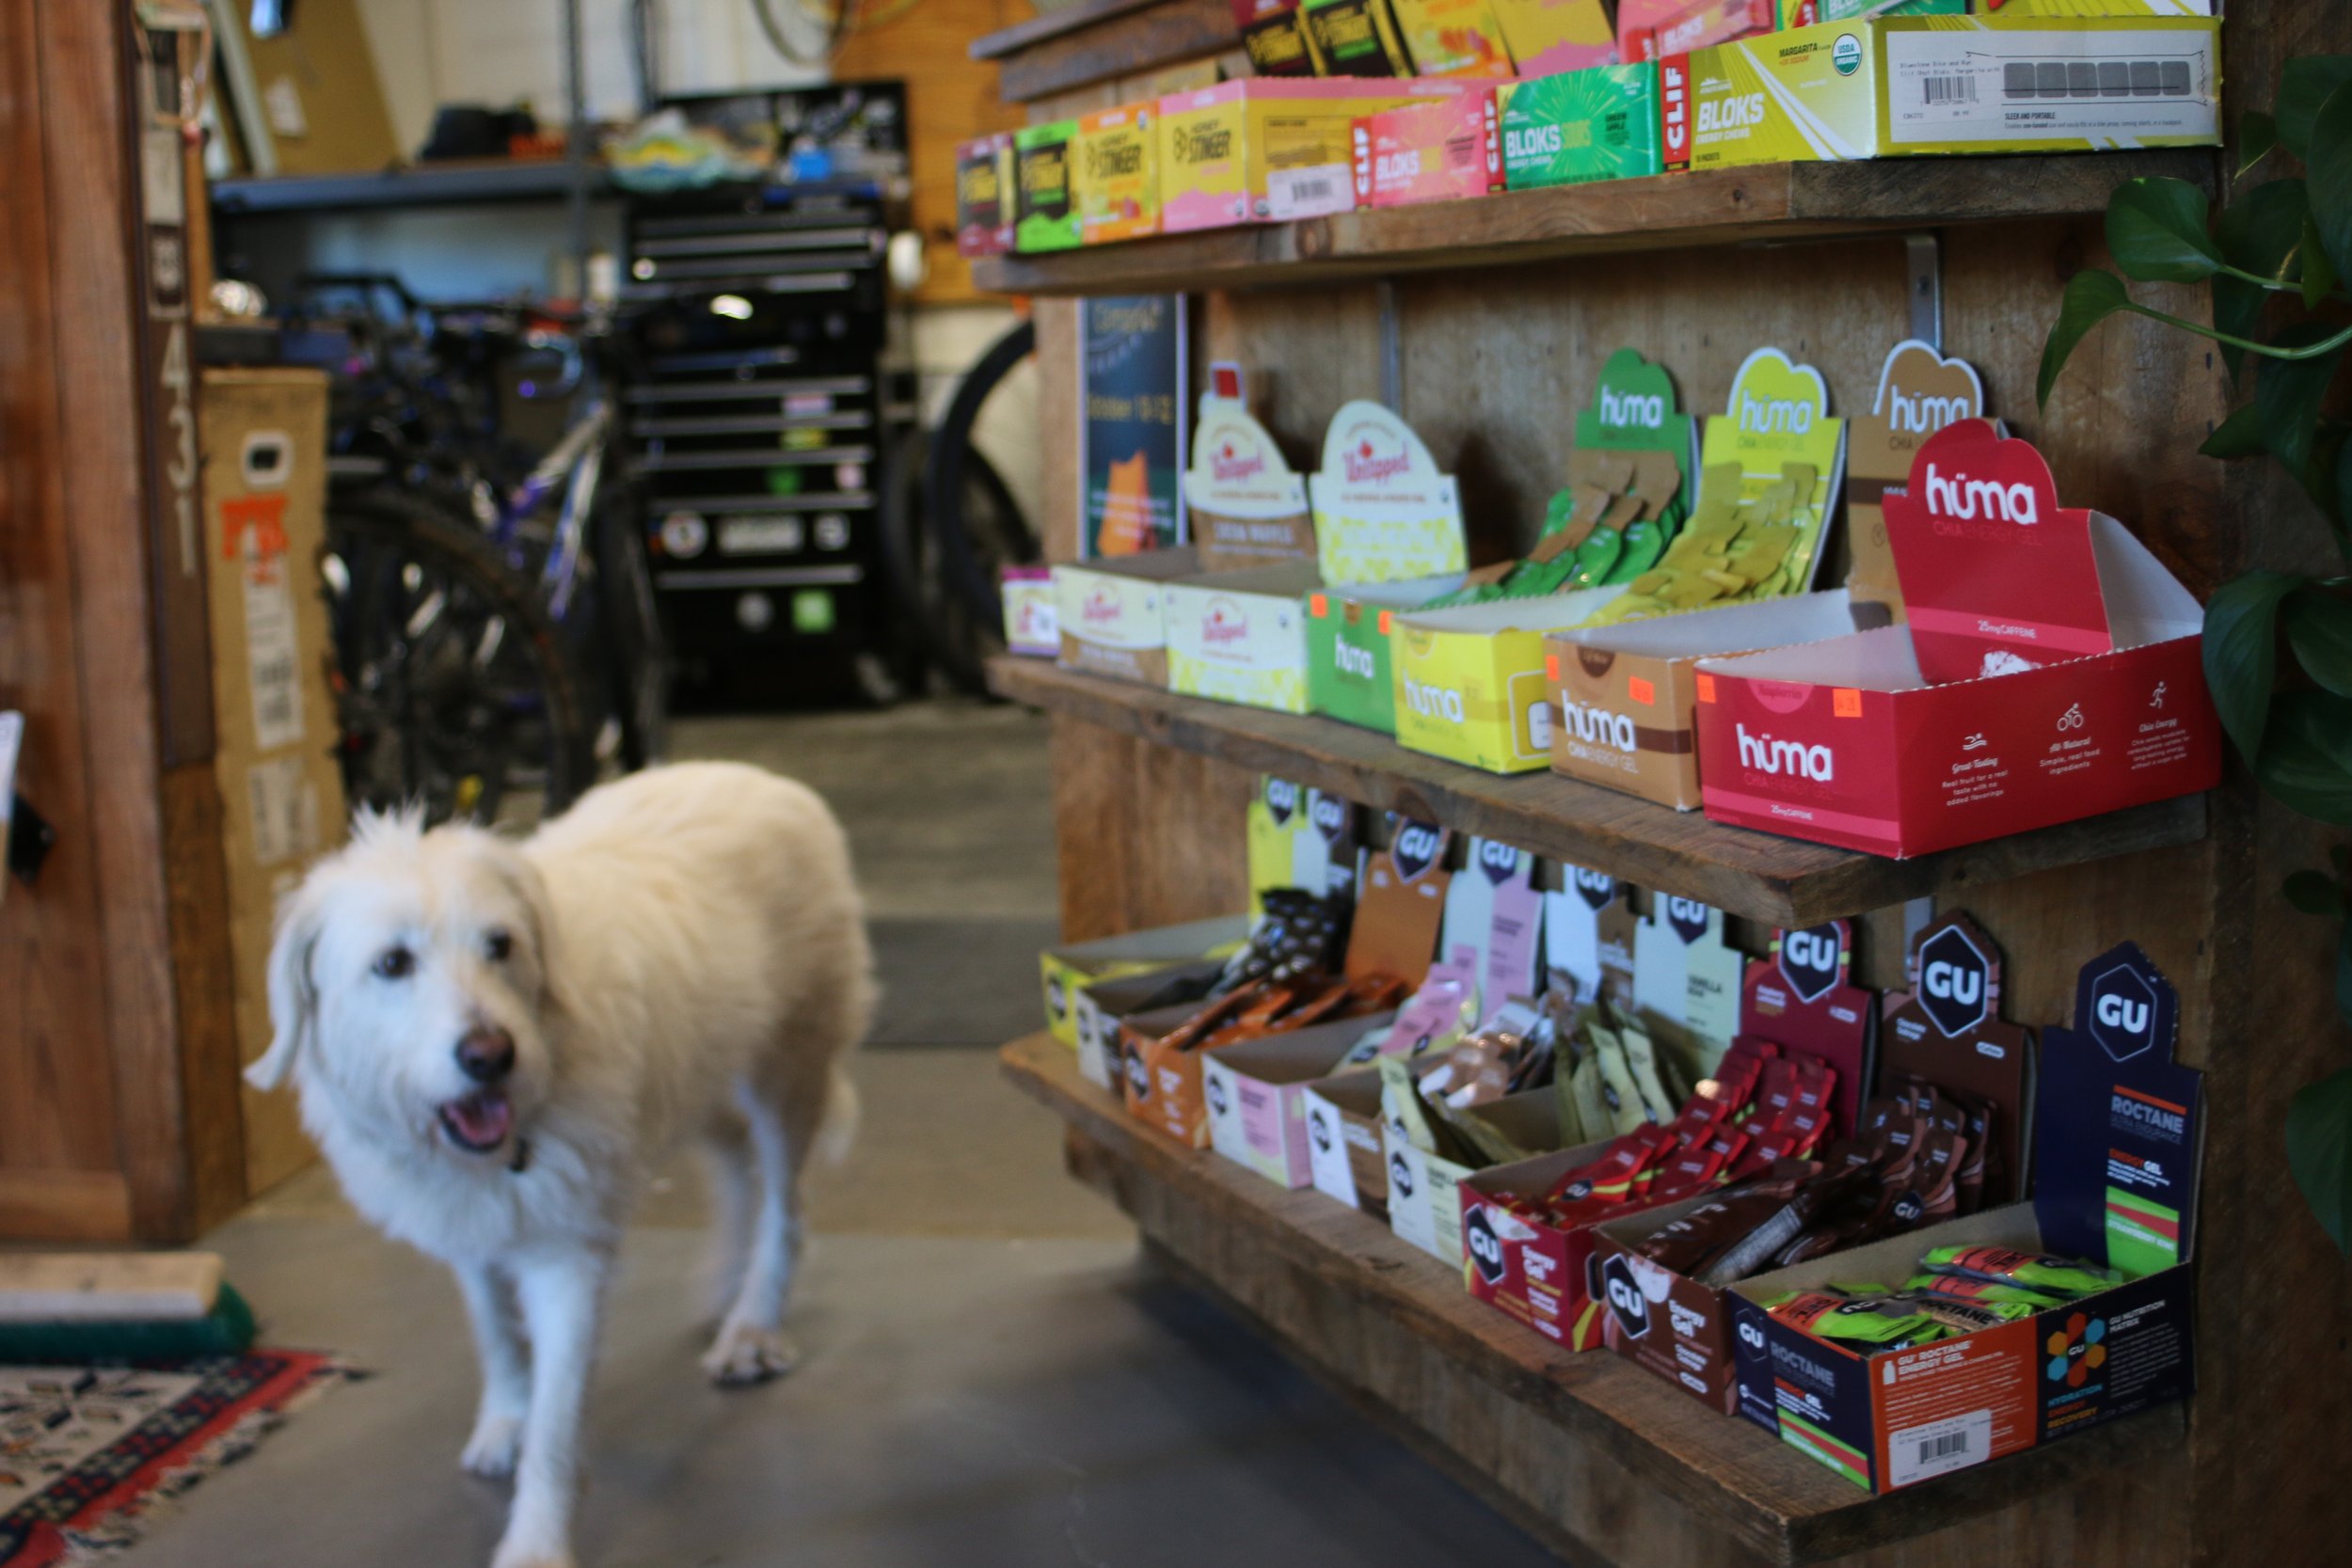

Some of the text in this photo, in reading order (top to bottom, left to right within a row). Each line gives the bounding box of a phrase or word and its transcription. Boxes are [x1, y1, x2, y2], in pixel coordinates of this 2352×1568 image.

[1779, 42, 1818, 58] MARGARITA
[1837, 43, 1856, 55] USDA
[1665, 67, 1685, 150] CLIF
[1696, 92, 1765, 132] BLOKS
[2005, 112, 2020, 120] SLEEK
[2031, 111, 2056, 119] PORTABLE
[1484, 99, 1500, 174] CLIF
[1505, 124, 1562, 158] BLOKS
[1354, 127, 1370, 196] CLIF
[1375, 150, 1420, 182] BLOKS
[1933, 520, 1963, 536] CHIA
[2049, 759, 2091, 776] ingredients
[2068, 752, 2083, 761] real
[2084, 748, 2101, 757] food
[1399, 827, 1437, 861] GU
[1482, 841, 1518, 870] GU
[1577, 868, 1612, 893] GU
[1670, 896, 1708, 926] GU
[1788, 929, 1836, 973] GU
[1925, 960, 1981, 1006] GU
[2097, 993, 2149, 1034] GU
[2111, 1095, 2184, 1135] ROCTANE
[1894, 1201, 1920, 1220] GU
[1470, 1227, 1502, 1264] GU
[1608, 1277, 1645, 1318] GU
[2109, 1299, 2167, 1325] GU NUTRITION
[1668, 1299, 1707, 1328] Energy
[2108, 1317, 2140, 1334] MATRIX
[1739, 1322, 1764, 1349] GU
[1919, 1339, 1972, 1361] ROCTANE
[2069, 1344, 2086, 1355] GU
[1770, 1339, 1835, 1388] ROCTANE
[1899, 1352, 1964, 1375] ENERGY GEL
[2047, 1383, 2105, 1408] HYDRATION
